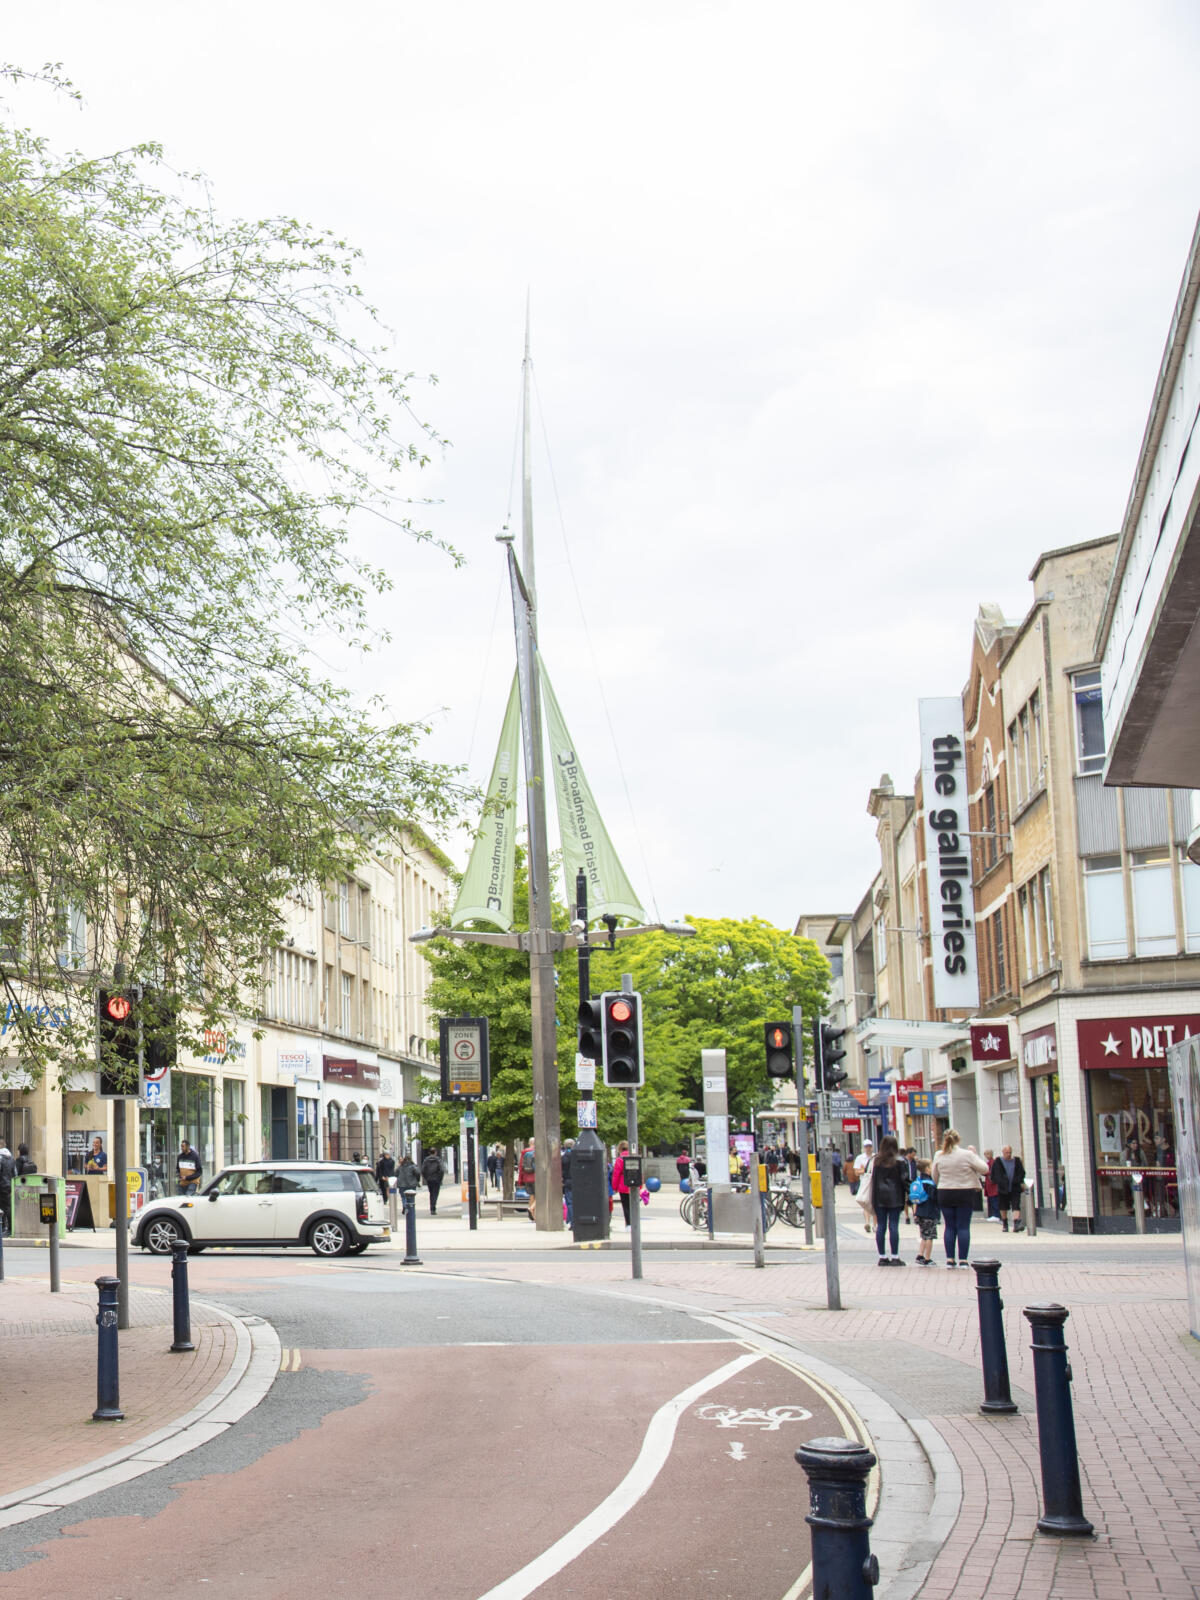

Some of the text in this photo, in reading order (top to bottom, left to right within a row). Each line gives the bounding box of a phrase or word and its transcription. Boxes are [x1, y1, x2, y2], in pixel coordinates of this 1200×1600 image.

[488, 822, 504, 895] Broadmead
[567, 766, 592, 840] Broadmead
[583, 842, 601, 885] Bristol
[929, 734, 971, 975] the galleries
[1130, 1025, 1175, 1059] PRET
